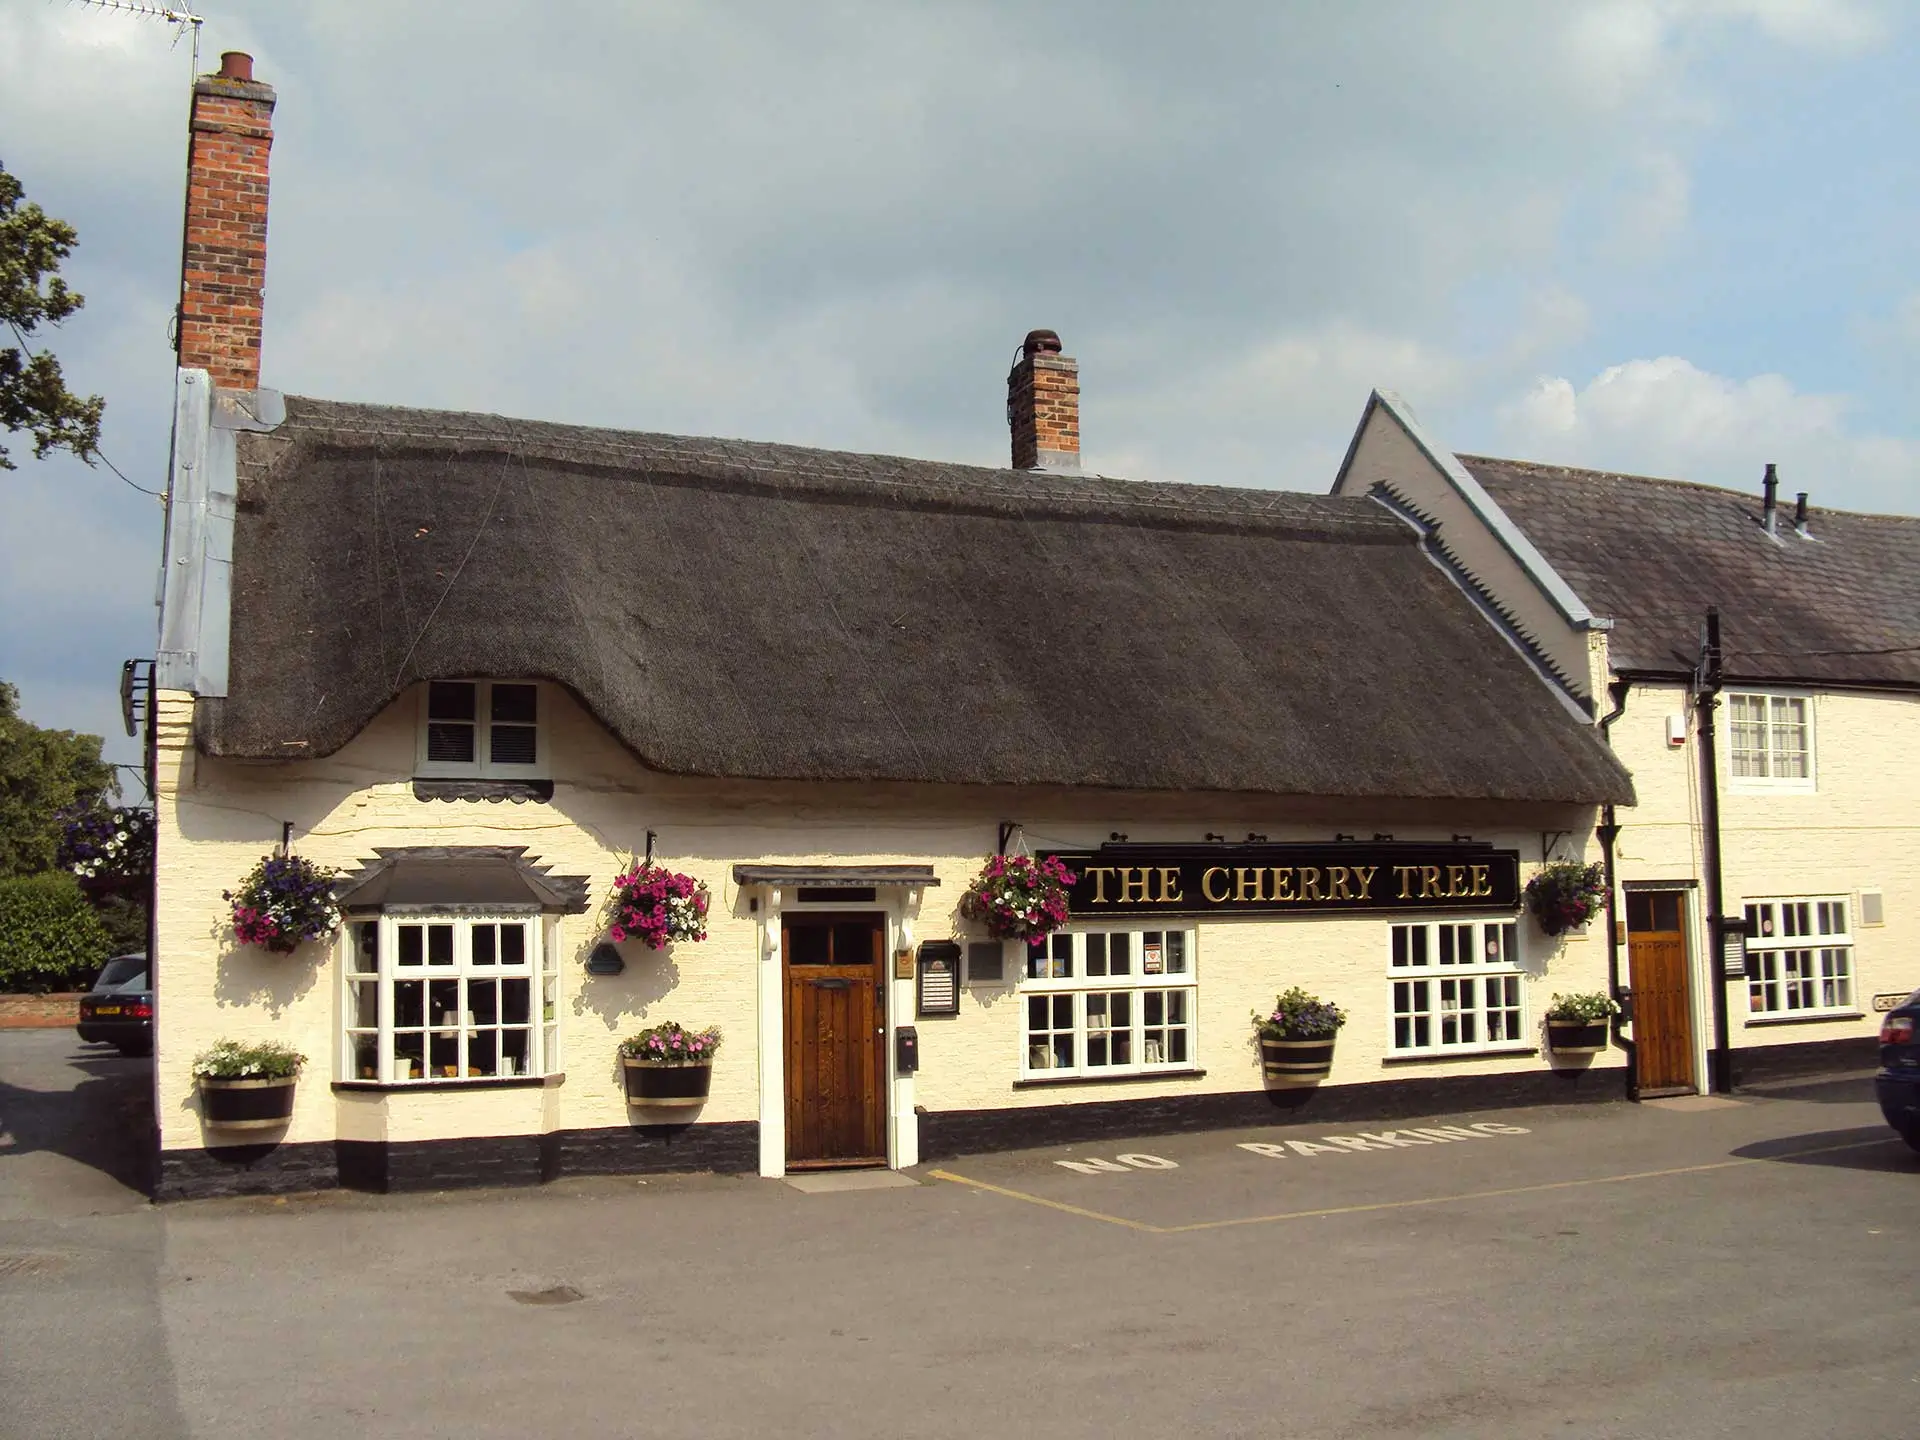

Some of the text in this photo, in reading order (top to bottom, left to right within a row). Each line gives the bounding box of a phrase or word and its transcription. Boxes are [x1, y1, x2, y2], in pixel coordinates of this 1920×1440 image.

[1085, 864, 1493, 904] THE CHERRY TREE
[1054, 1122, 1532, 1175] NO PARKING
